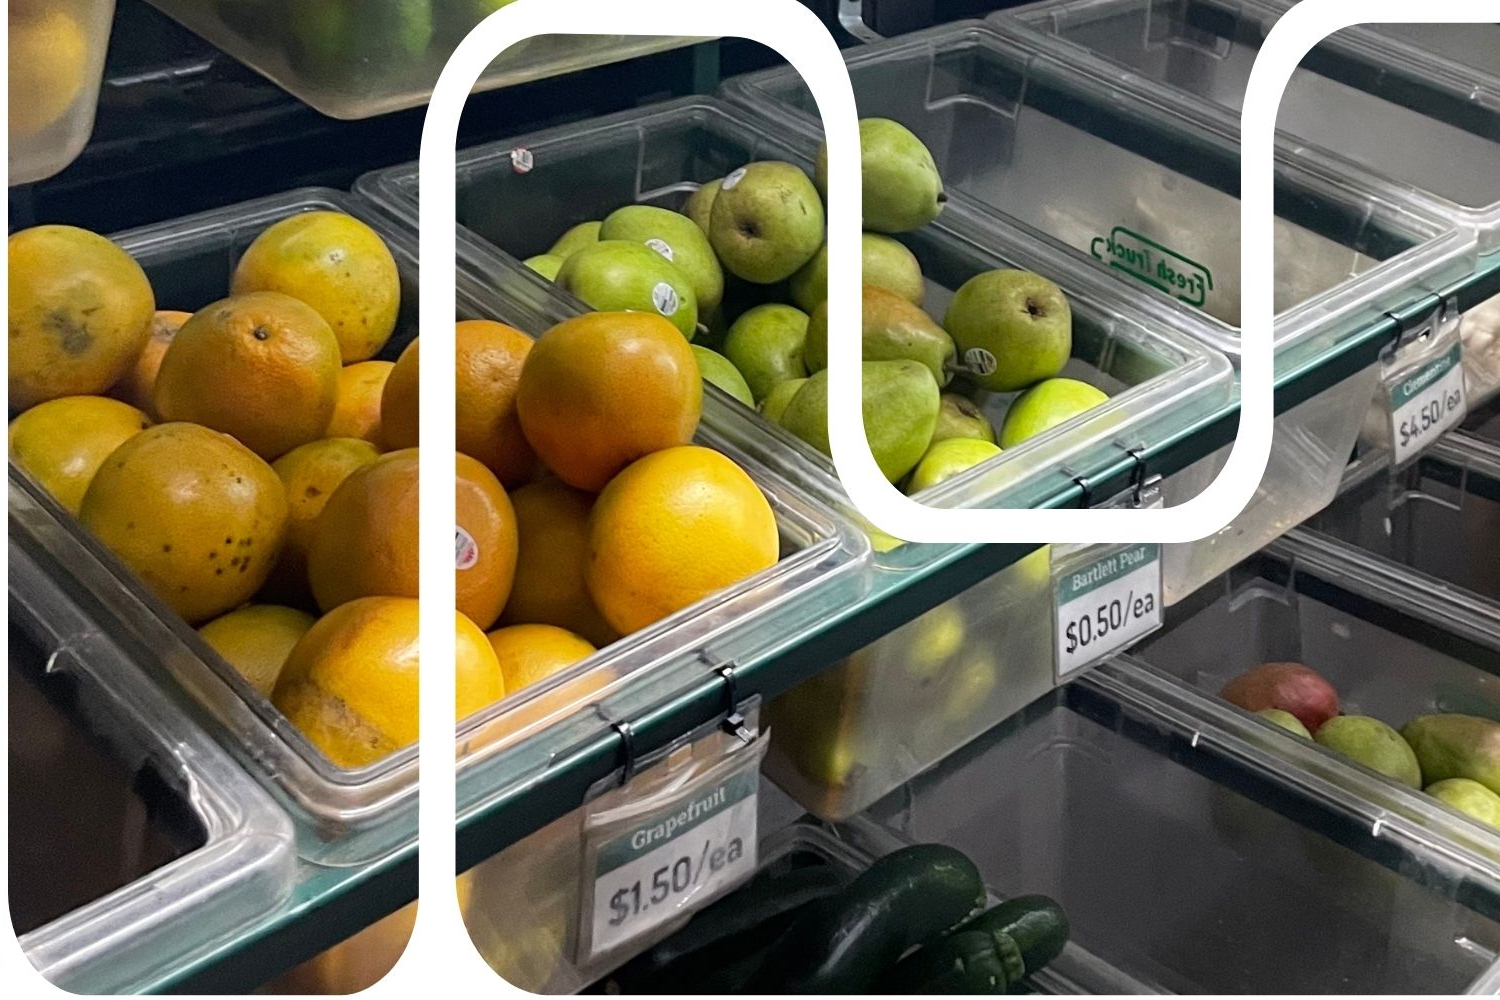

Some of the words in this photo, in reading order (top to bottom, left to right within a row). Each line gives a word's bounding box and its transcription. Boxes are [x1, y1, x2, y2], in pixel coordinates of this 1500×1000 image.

[1400, 389, 1461, 447] $4.50/ea
[1071, 558, 1117, 592] Bartlett
[1119, 547, 1146, 572] Pear
[1066, 590, 1154, 654] $0.50/ea
[631, 787, 726, 850] Grapefruit
[609, 836, 743, 927] $1.50/ea
